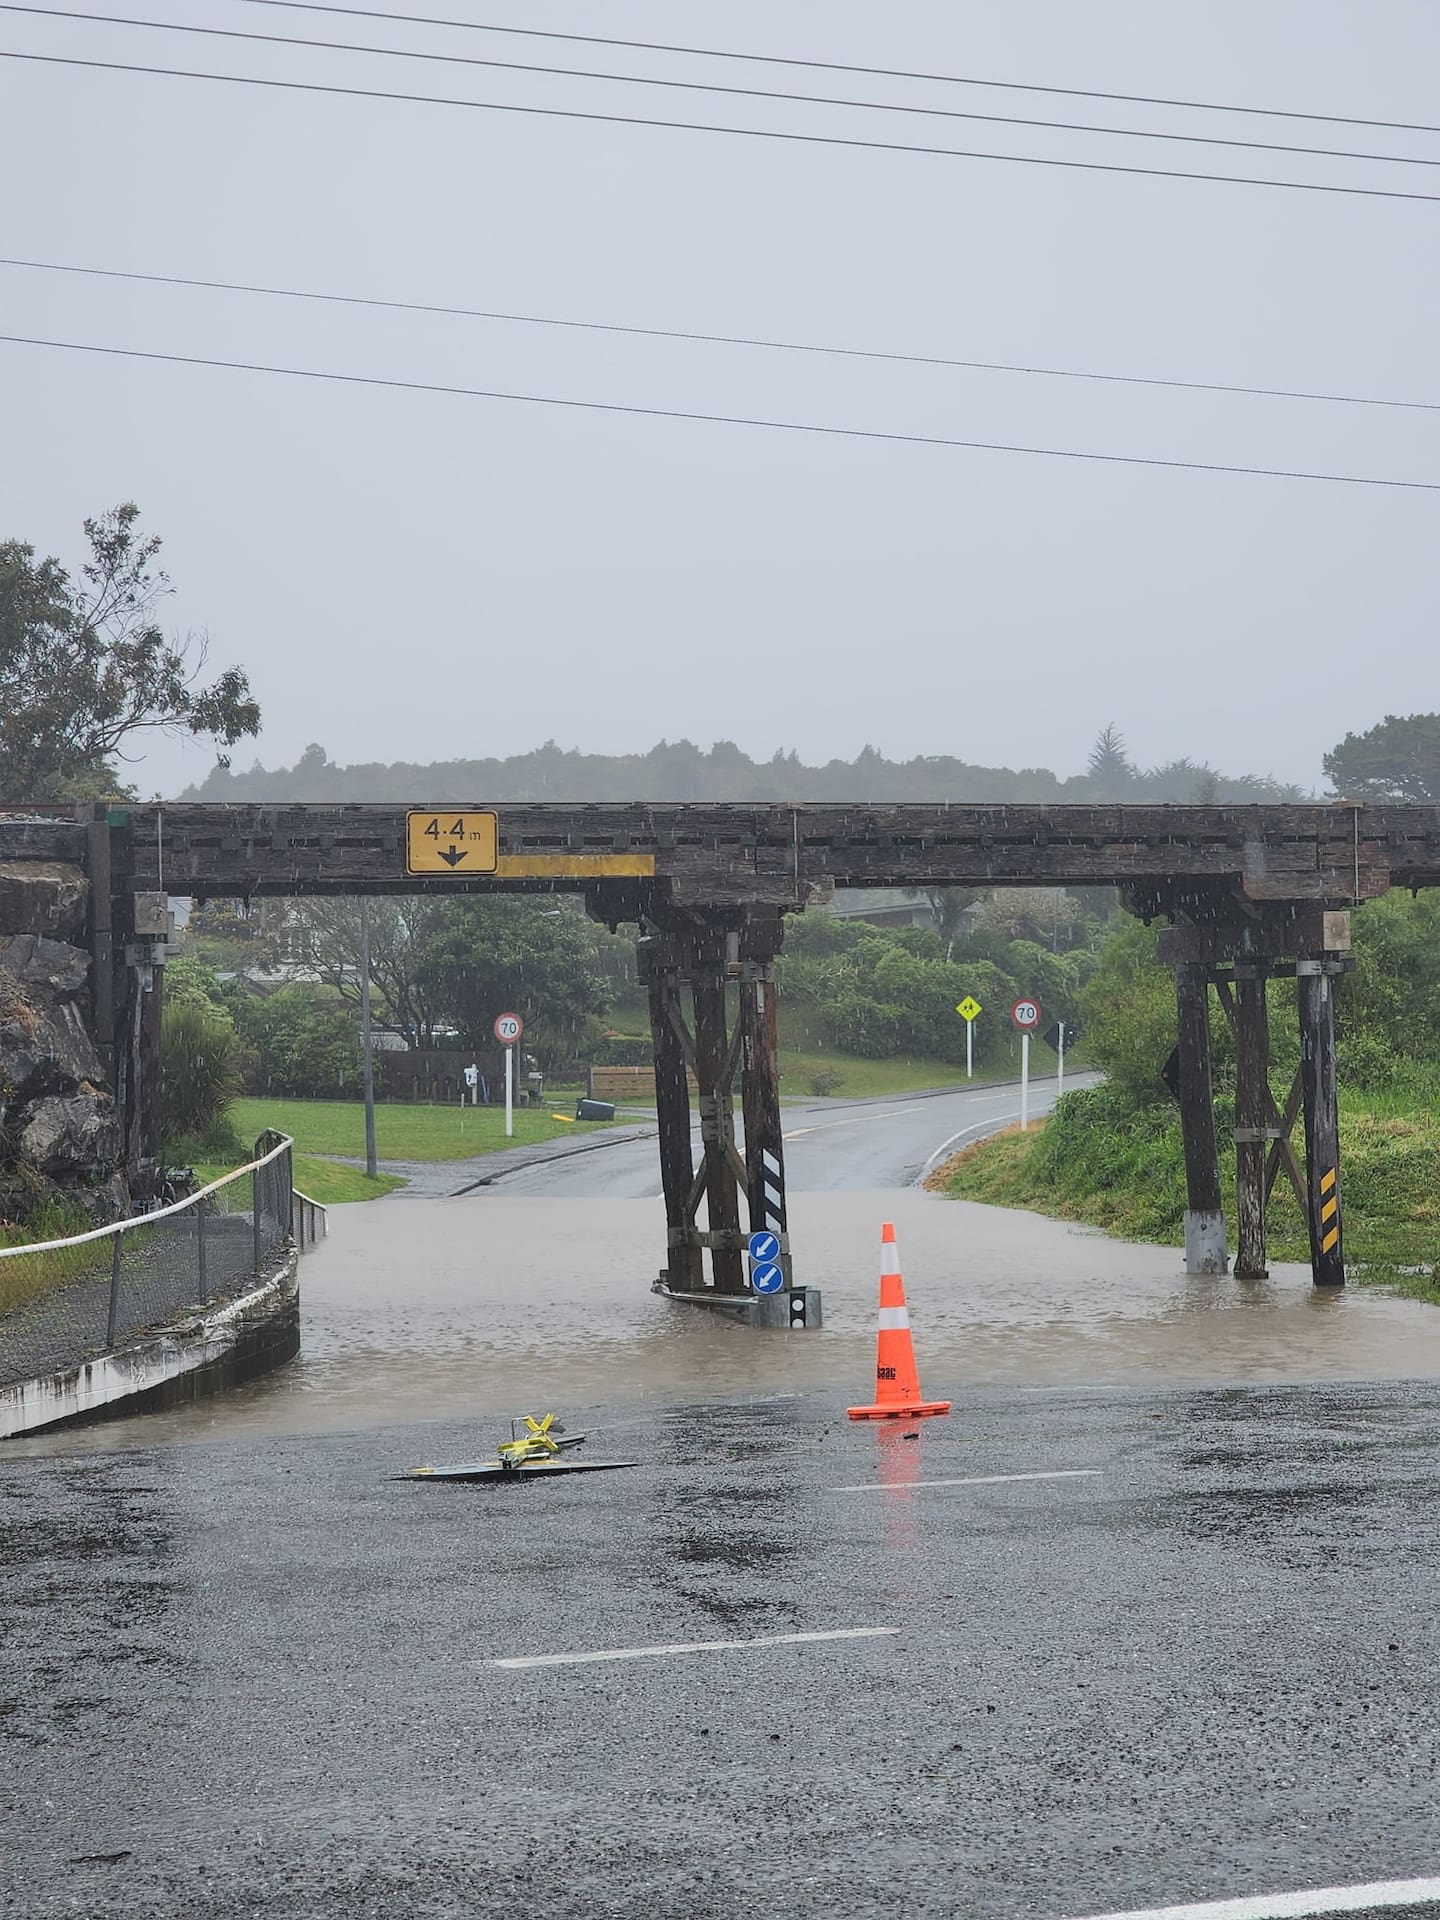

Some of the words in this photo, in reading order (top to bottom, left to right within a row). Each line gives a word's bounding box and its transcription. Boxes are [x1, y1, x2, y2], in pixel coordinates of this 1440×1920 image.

[470, 831, 481, 841] m
[1018, 1007, 1034, 1019] 70
[501, 1022, 517, 1034] 70
